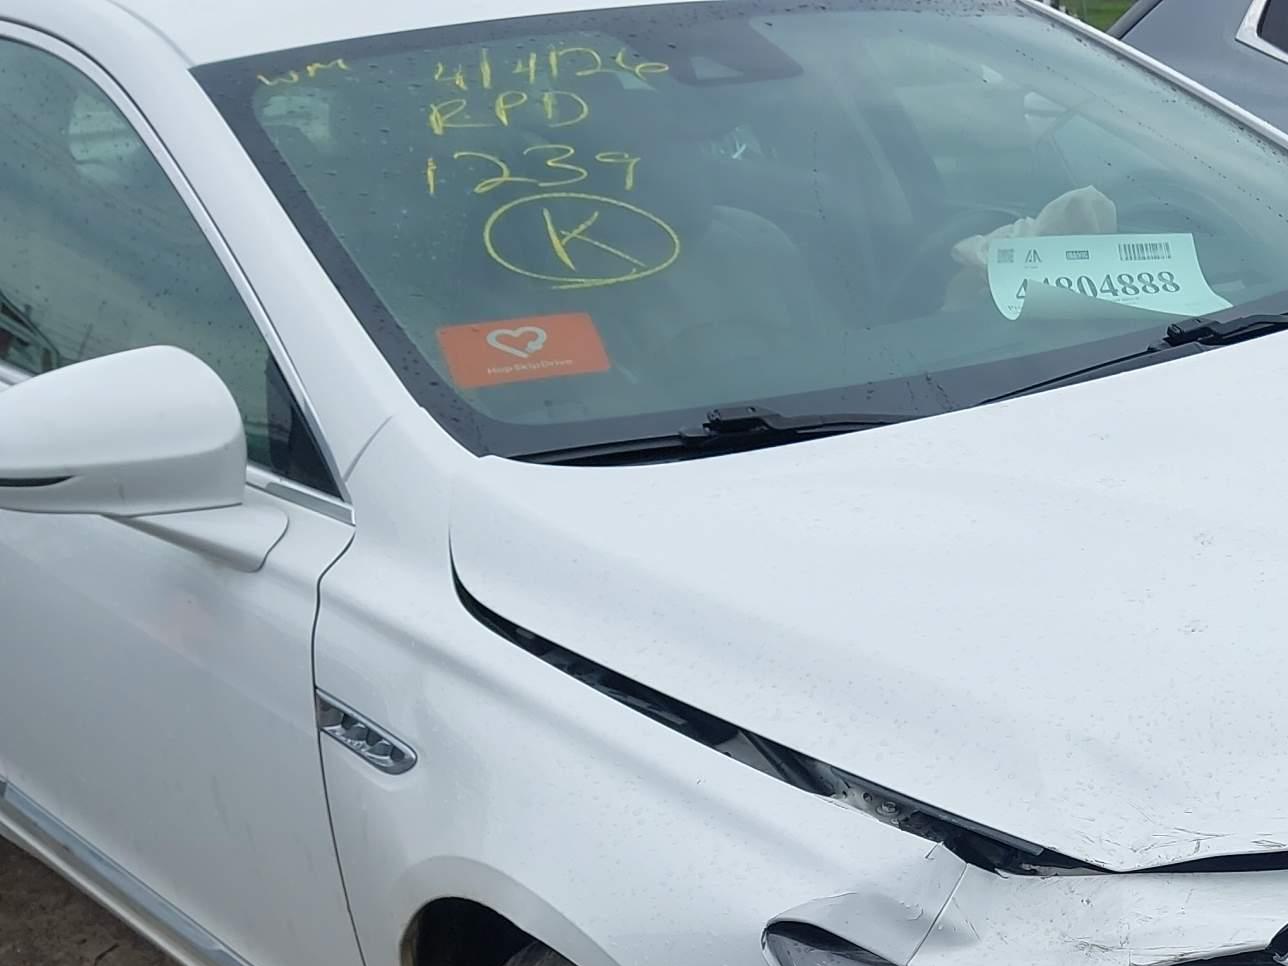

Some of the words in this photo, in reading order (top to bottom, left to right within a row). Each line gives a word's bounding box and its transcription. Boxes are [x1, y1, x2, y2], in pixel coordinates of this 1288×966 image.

[429, 90, 589, 135] RPD
[426, 144, 641, 194] 1239
[543, 207, 646, 271] K
